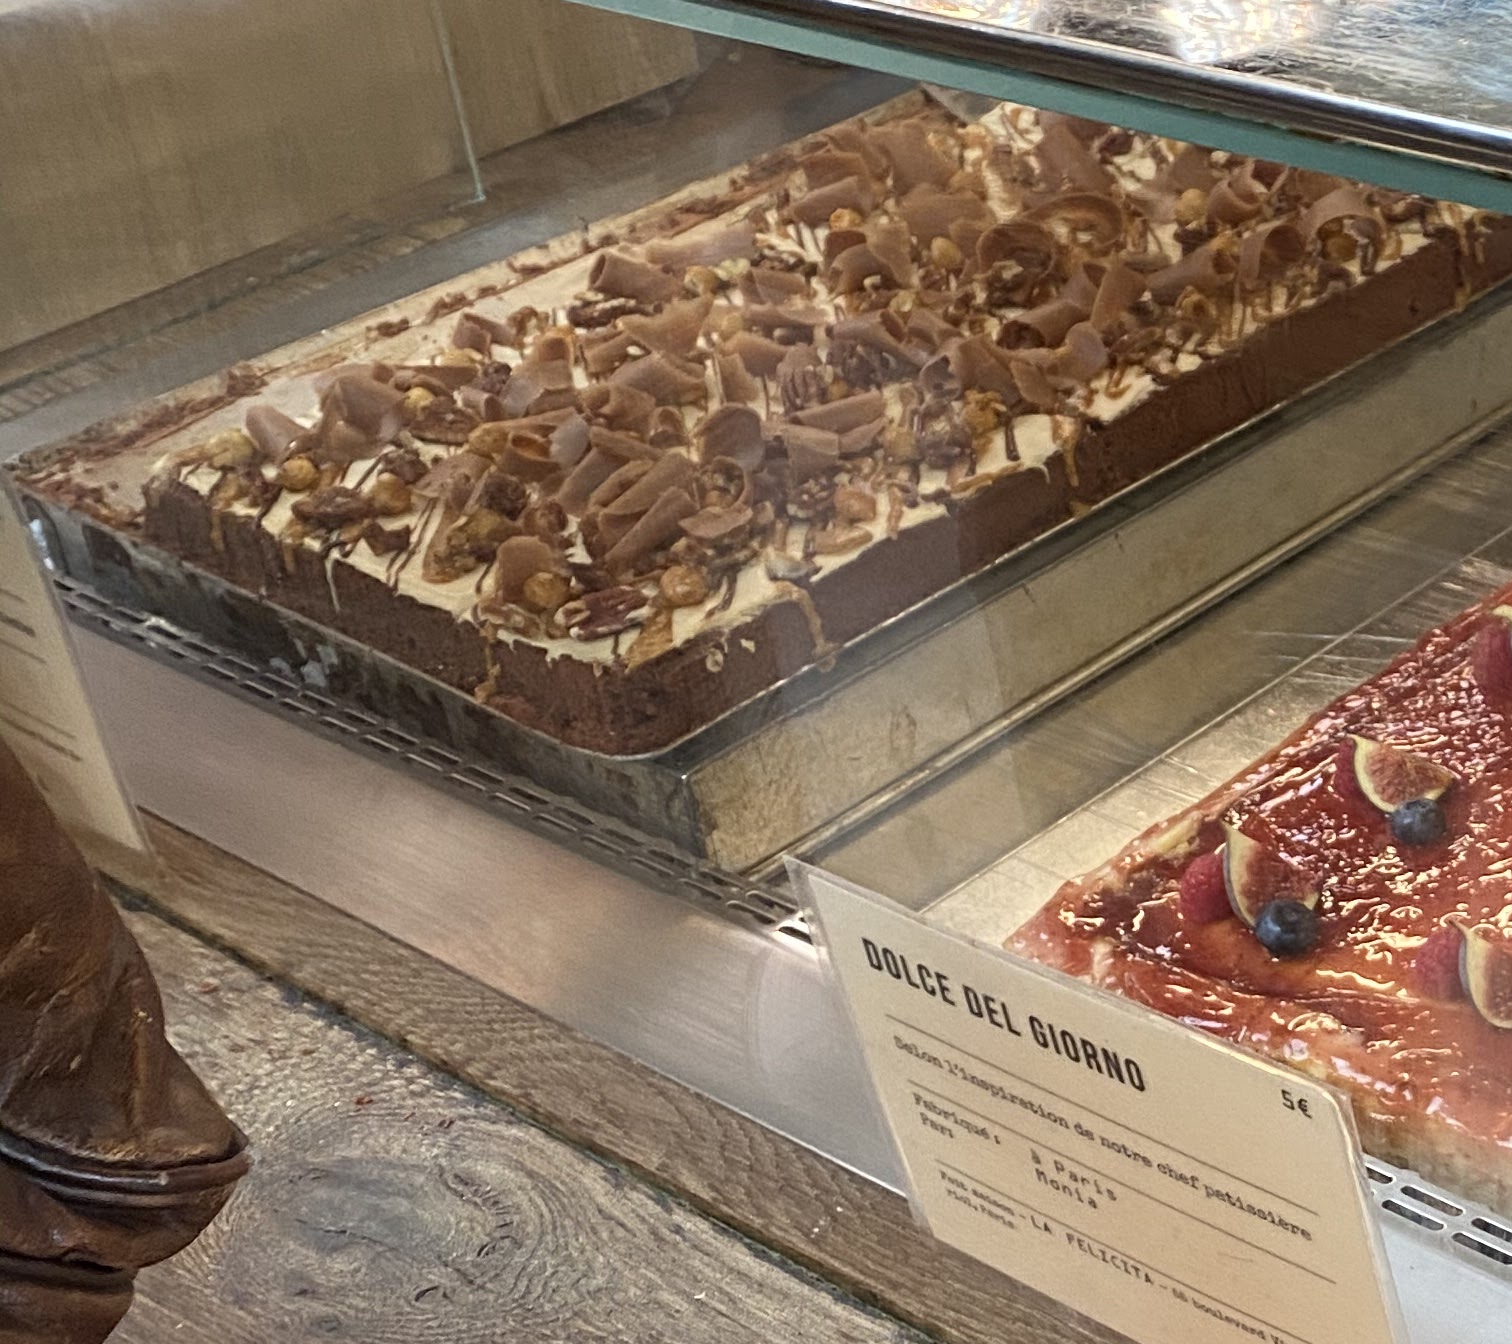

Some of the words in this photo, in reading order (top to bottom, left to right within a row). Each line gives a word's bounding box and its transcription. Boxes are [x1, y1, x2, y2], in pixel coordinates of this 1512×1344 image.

[862, 937, 955, 1006] DOLCE
[963, 984, 1021, 1037] DEL
[1029, 1015, 1146, 1092] GIORNO
[1281, 1089, 1312, 1119] 5€
[1054, 1159, 1118, 1201] Paris
[1074, 1121, 1095, 1141] de
[1100, 1136, 1152, 1168] notre
[1157, 1161, 1199, 1190] chef
[1031, 1215, 1052, 1234] LA
[1066, 1232, 1154, 1285] FELICITA
[1192, 1298, 1266, 1341] boulevard
